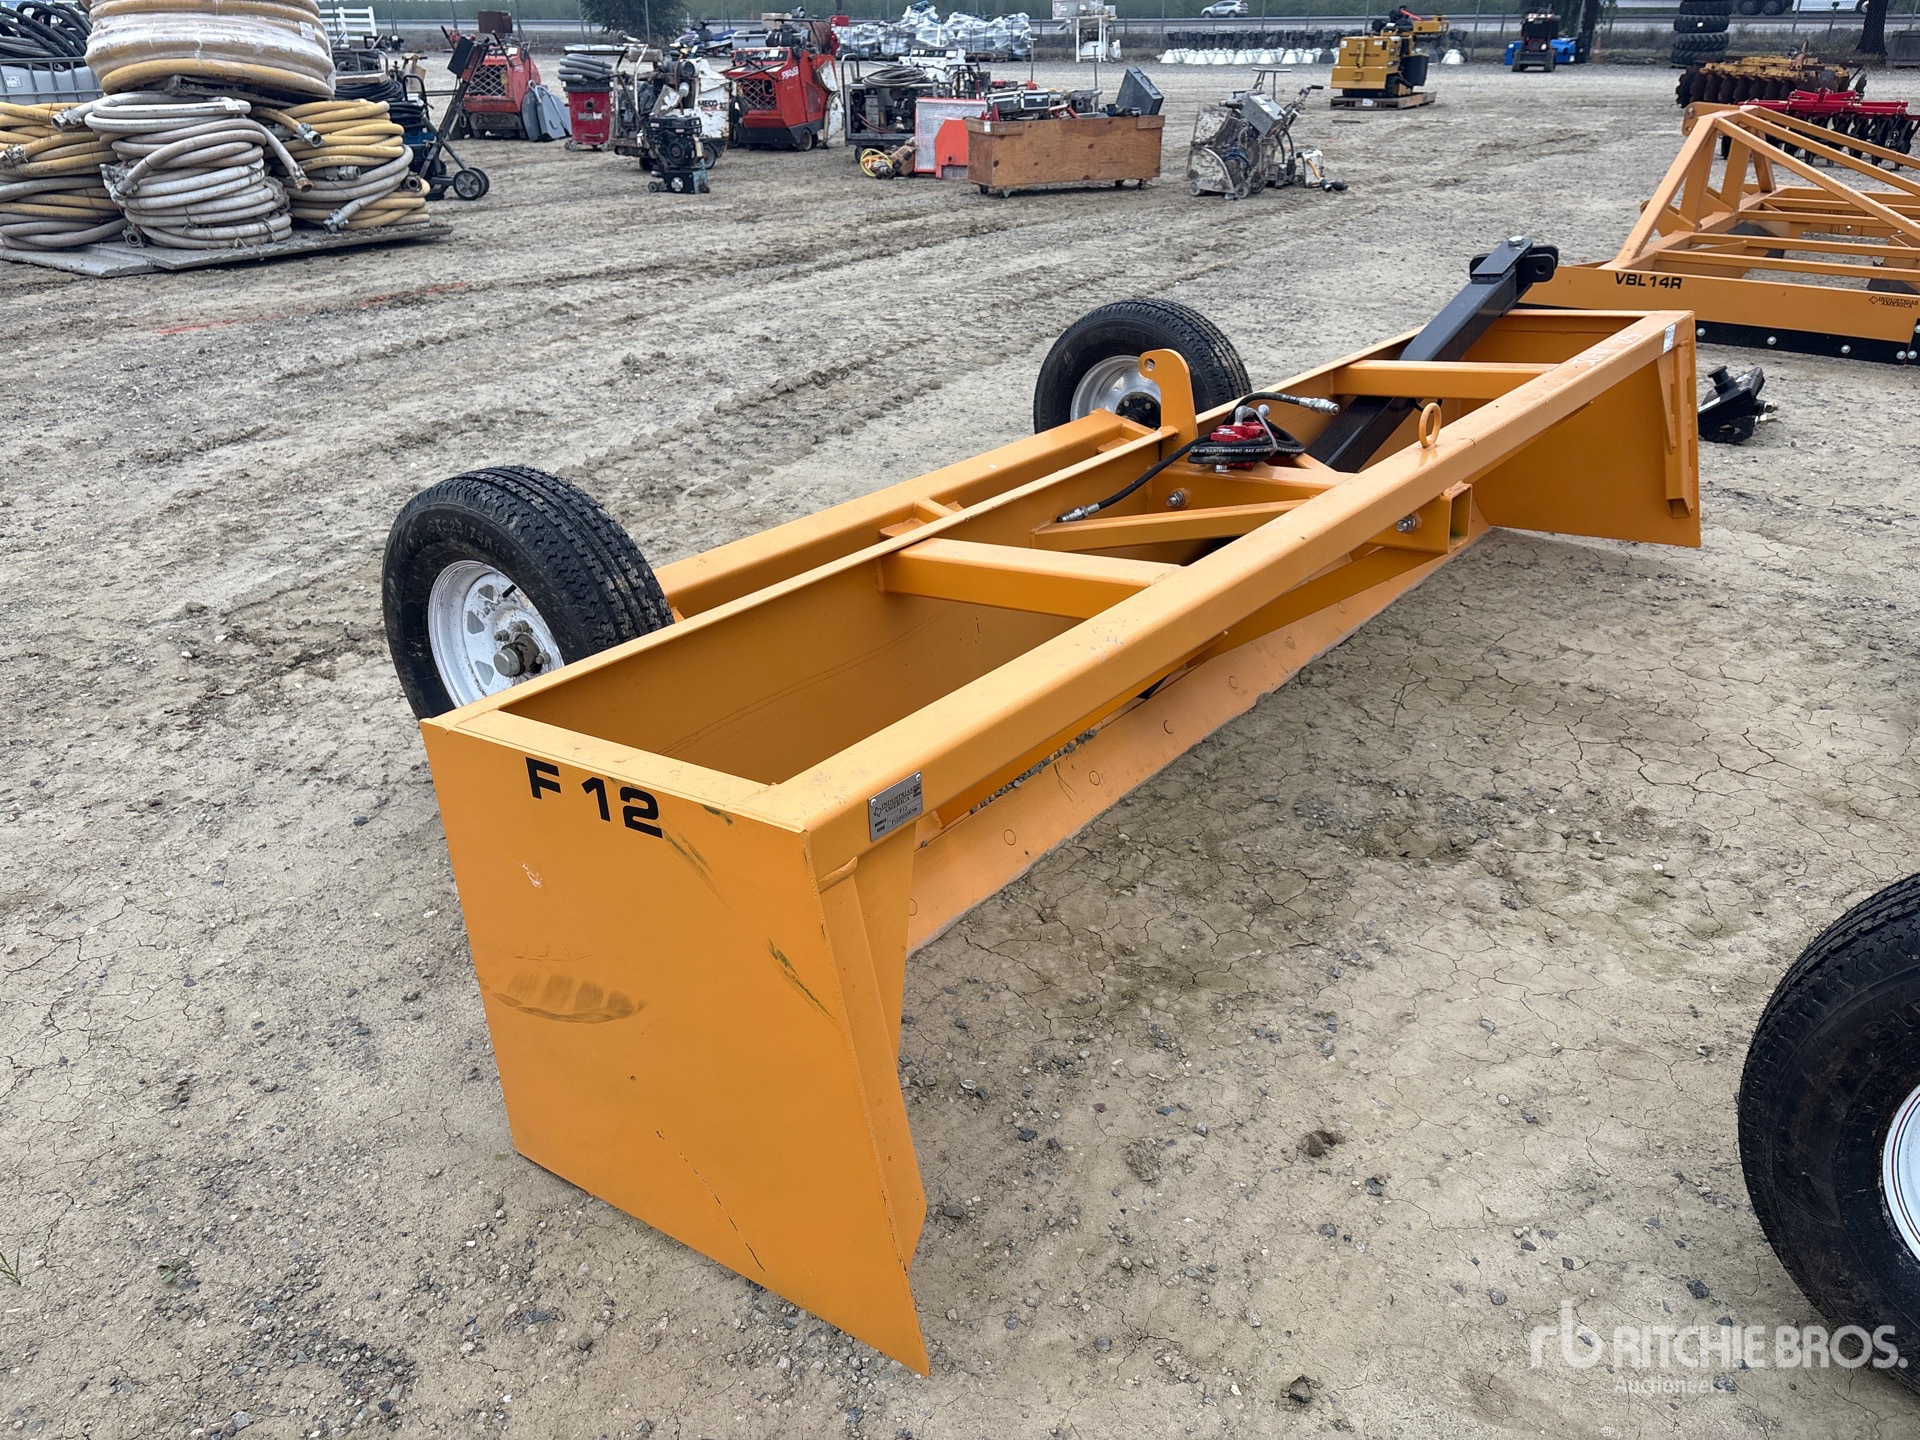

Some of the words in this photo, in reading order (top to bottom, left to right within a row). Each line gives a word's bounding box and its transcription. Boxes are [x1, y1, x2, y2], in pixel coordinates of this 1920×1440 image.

[1615, 272, 1646, 287] VBL
[1649, 275, 1682, 290] 14R
[1878, 296, 1919, 306] INDUSTRIAS
[1881, 300, 1912, 309] AMERICA
[525, 757, 561, 800] F
[581, 776, 663, 839] 12
[881, 787, 913, 809] INDUSTRIAS
[884, 796, 910, 814] AMERICA
